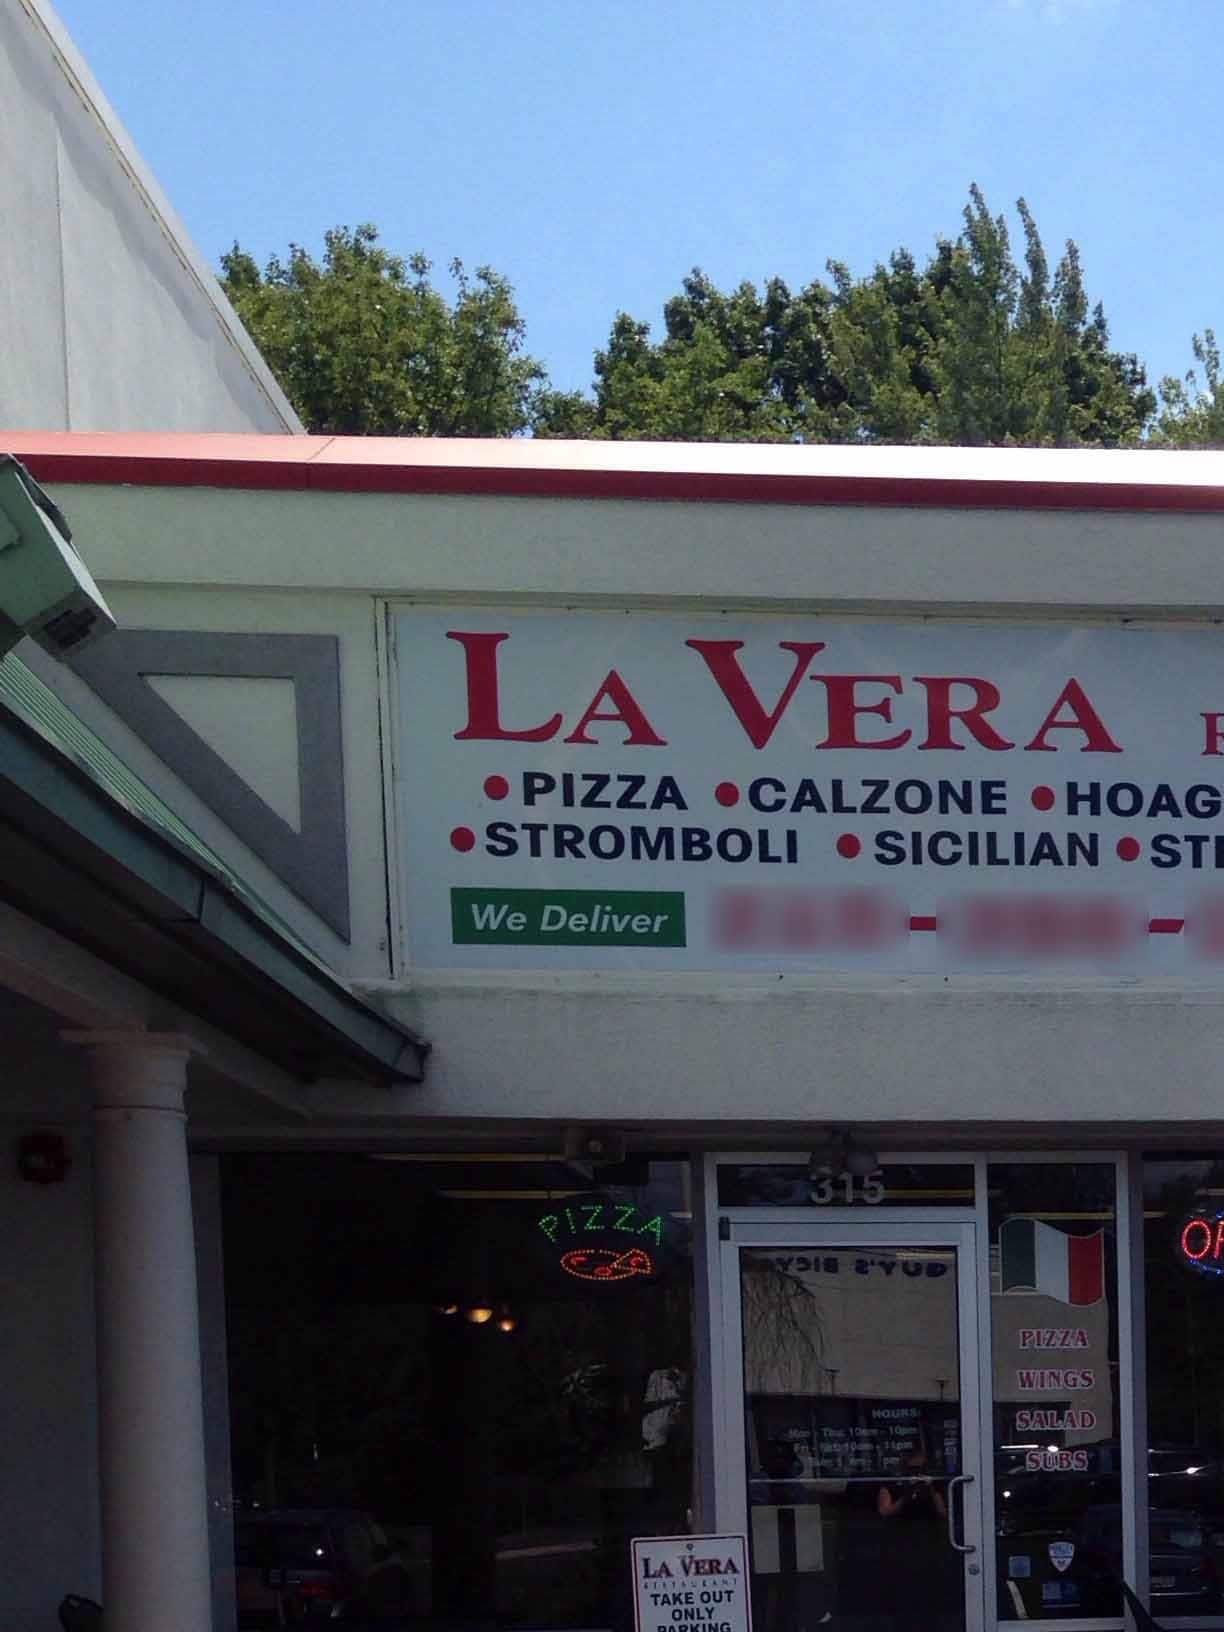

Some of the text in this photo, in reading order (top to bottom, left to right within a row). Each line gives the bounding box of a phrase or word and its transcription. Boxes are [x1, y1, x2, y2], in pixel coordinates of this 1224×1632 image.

[445, 631, 1123, 752] LA VERA
[522, 771, 689, 810] PIZZA
[747, 776, 1008, 814] CALZONE
[484, 820, 799, 864] STROMBOLI
[873, 829, 1099, 867] SICILIAN
[471, 903, 669, 935] We Deliver
[808, 1165, 886, 1204] 315
[538, 1205, 665, 1246] PIZZA
[1018, 1328, 1090, 1350] PIZZA
[1017, 1369, 1095, 1390] WINGS
[1016, 1410, 1097, 1431] SALAD
[1026, 1450, 1089, 1471] SUBS
[642, 1554, 740, 1579] LA VERA
[650, 1589, 735, 1607] TAKE OUT
[671, 1606, 715, 1622] ONLY
